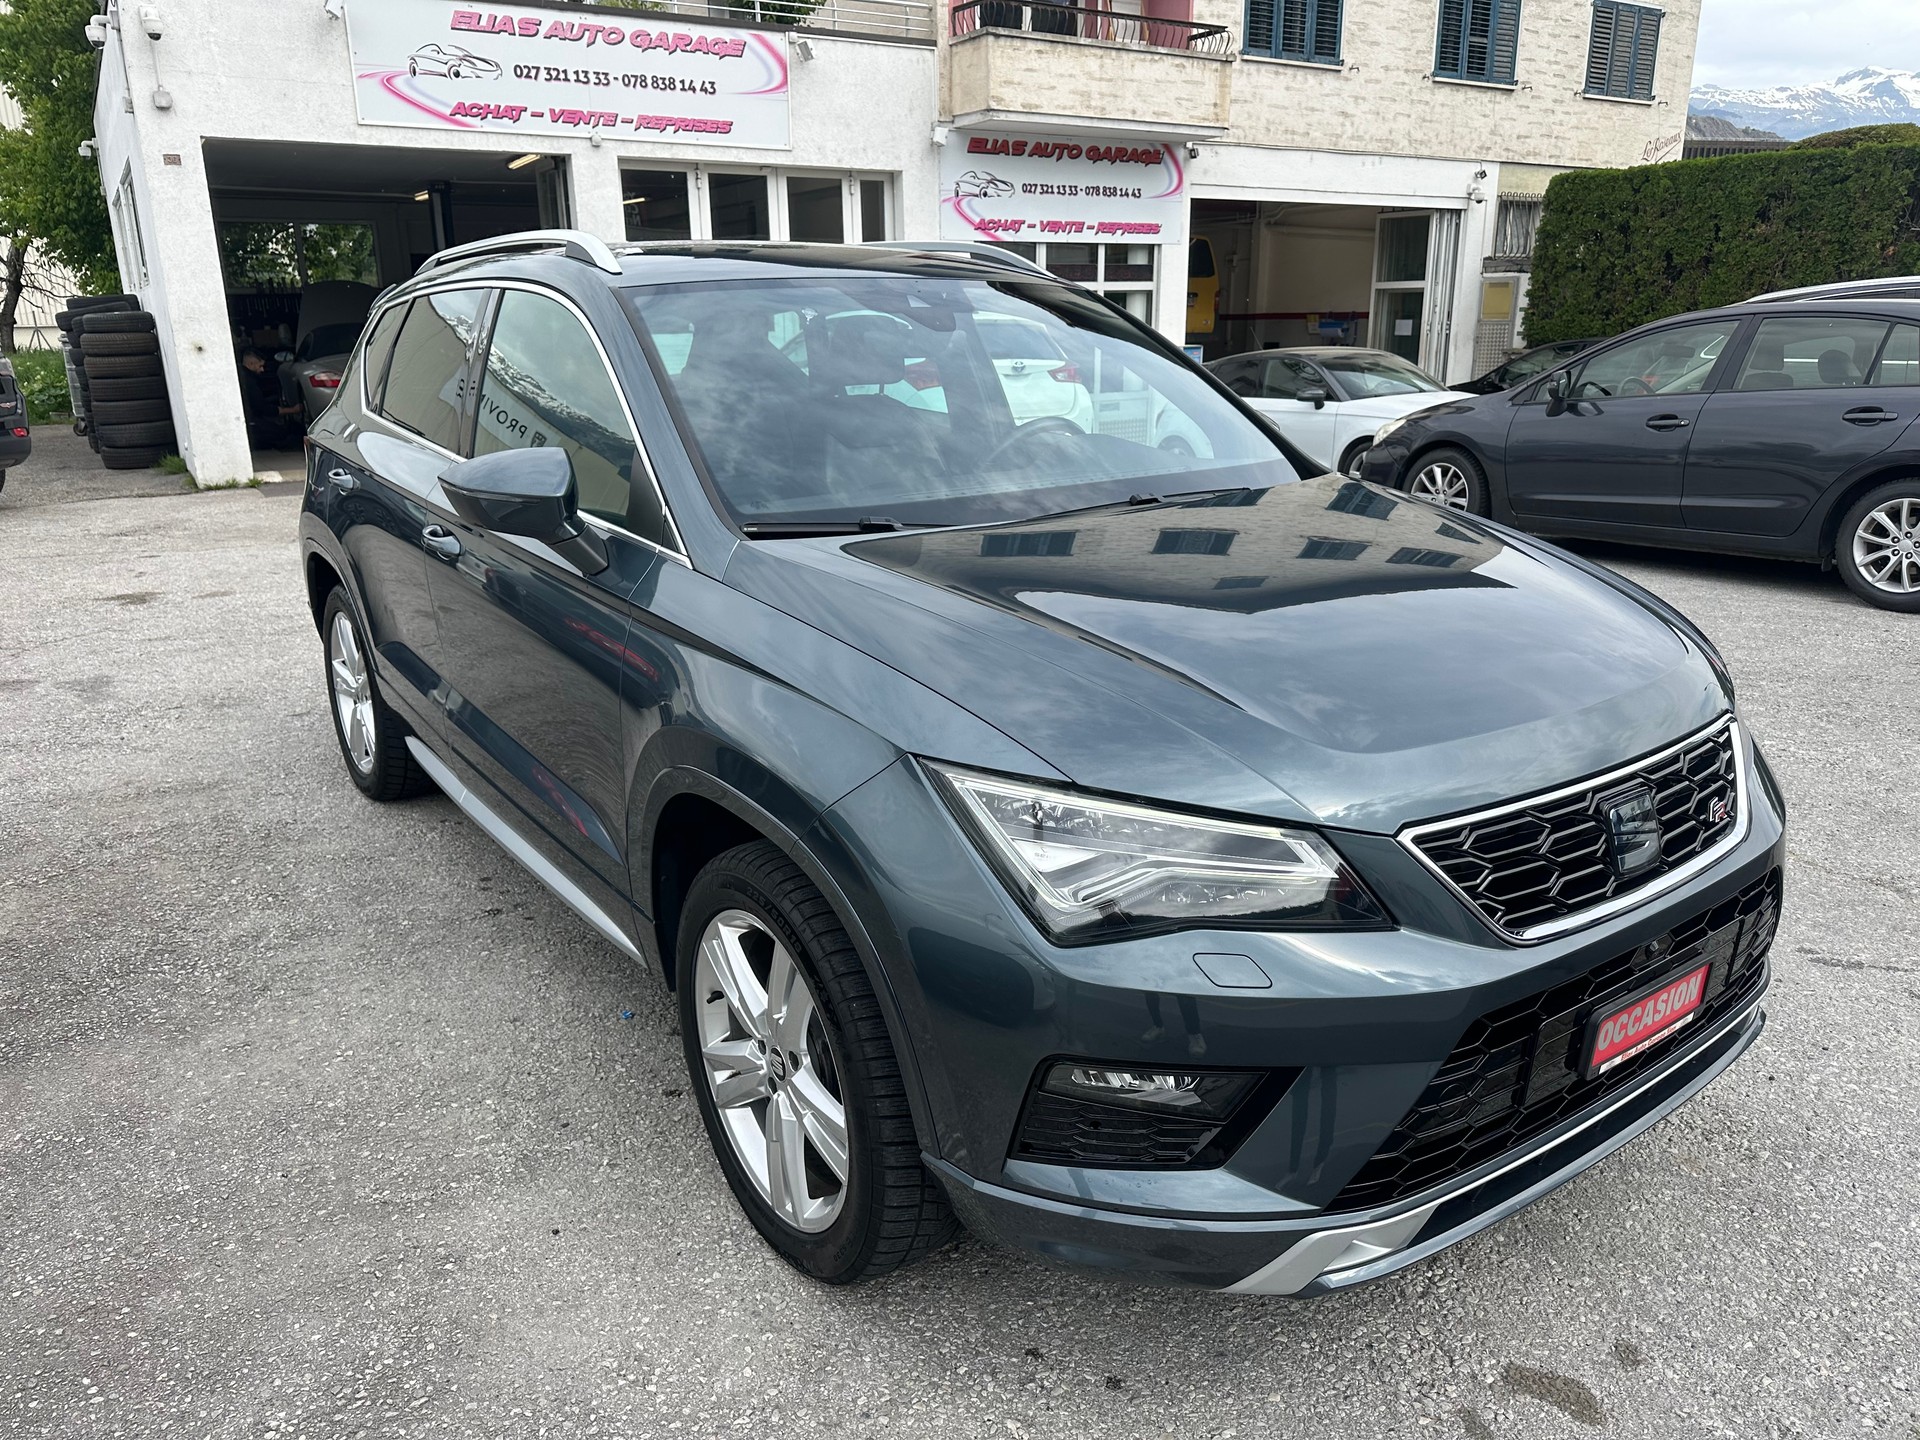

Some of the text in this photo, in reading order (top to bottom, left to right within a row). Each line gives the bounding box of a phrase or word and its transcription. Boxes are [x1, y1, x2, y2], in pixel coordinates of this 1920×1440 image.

[450, 10, 746, 60] ELIAS AUTO GARAGE
[513, 64, 541, 81] 027
[543, 66, 570, 83] 321
[573, 69, 590, 85] 13
[592, 71, 611, 87] 33
[621, 73, 648, 89] 078
[650, 75, 677, 91] 838
[679, 78, 697, 94] 14
[699, 80, 717, 95] 43
[449, 101, 527, 124] ACHAT
[548, 107, 618, 129] VENTE
[634, 114, 733, 135] REPRISES
[967, 137, 1165, 167] ELIAS AUTO GARAGE
[1021, 183, 1038, 195] 027
[1039, 183, 1055, 195] 321
[1056, 184, 1067, 196] 13
[1067, 185, 1079, 196] 33
[1085, 185, 1101, 197] 078
[1102, 186, 1118, 198] 838
[1119, 187, 1130, 198] 14
[1131, 187, 1142, 199] 43
[974, 218, 1025, 234] ACHAT
[1039, 220, 1085, 235] VENTE
[1094, 222, 1162, 236] REPRISES
[1597, 972, 1703, 1051] OCCASION
